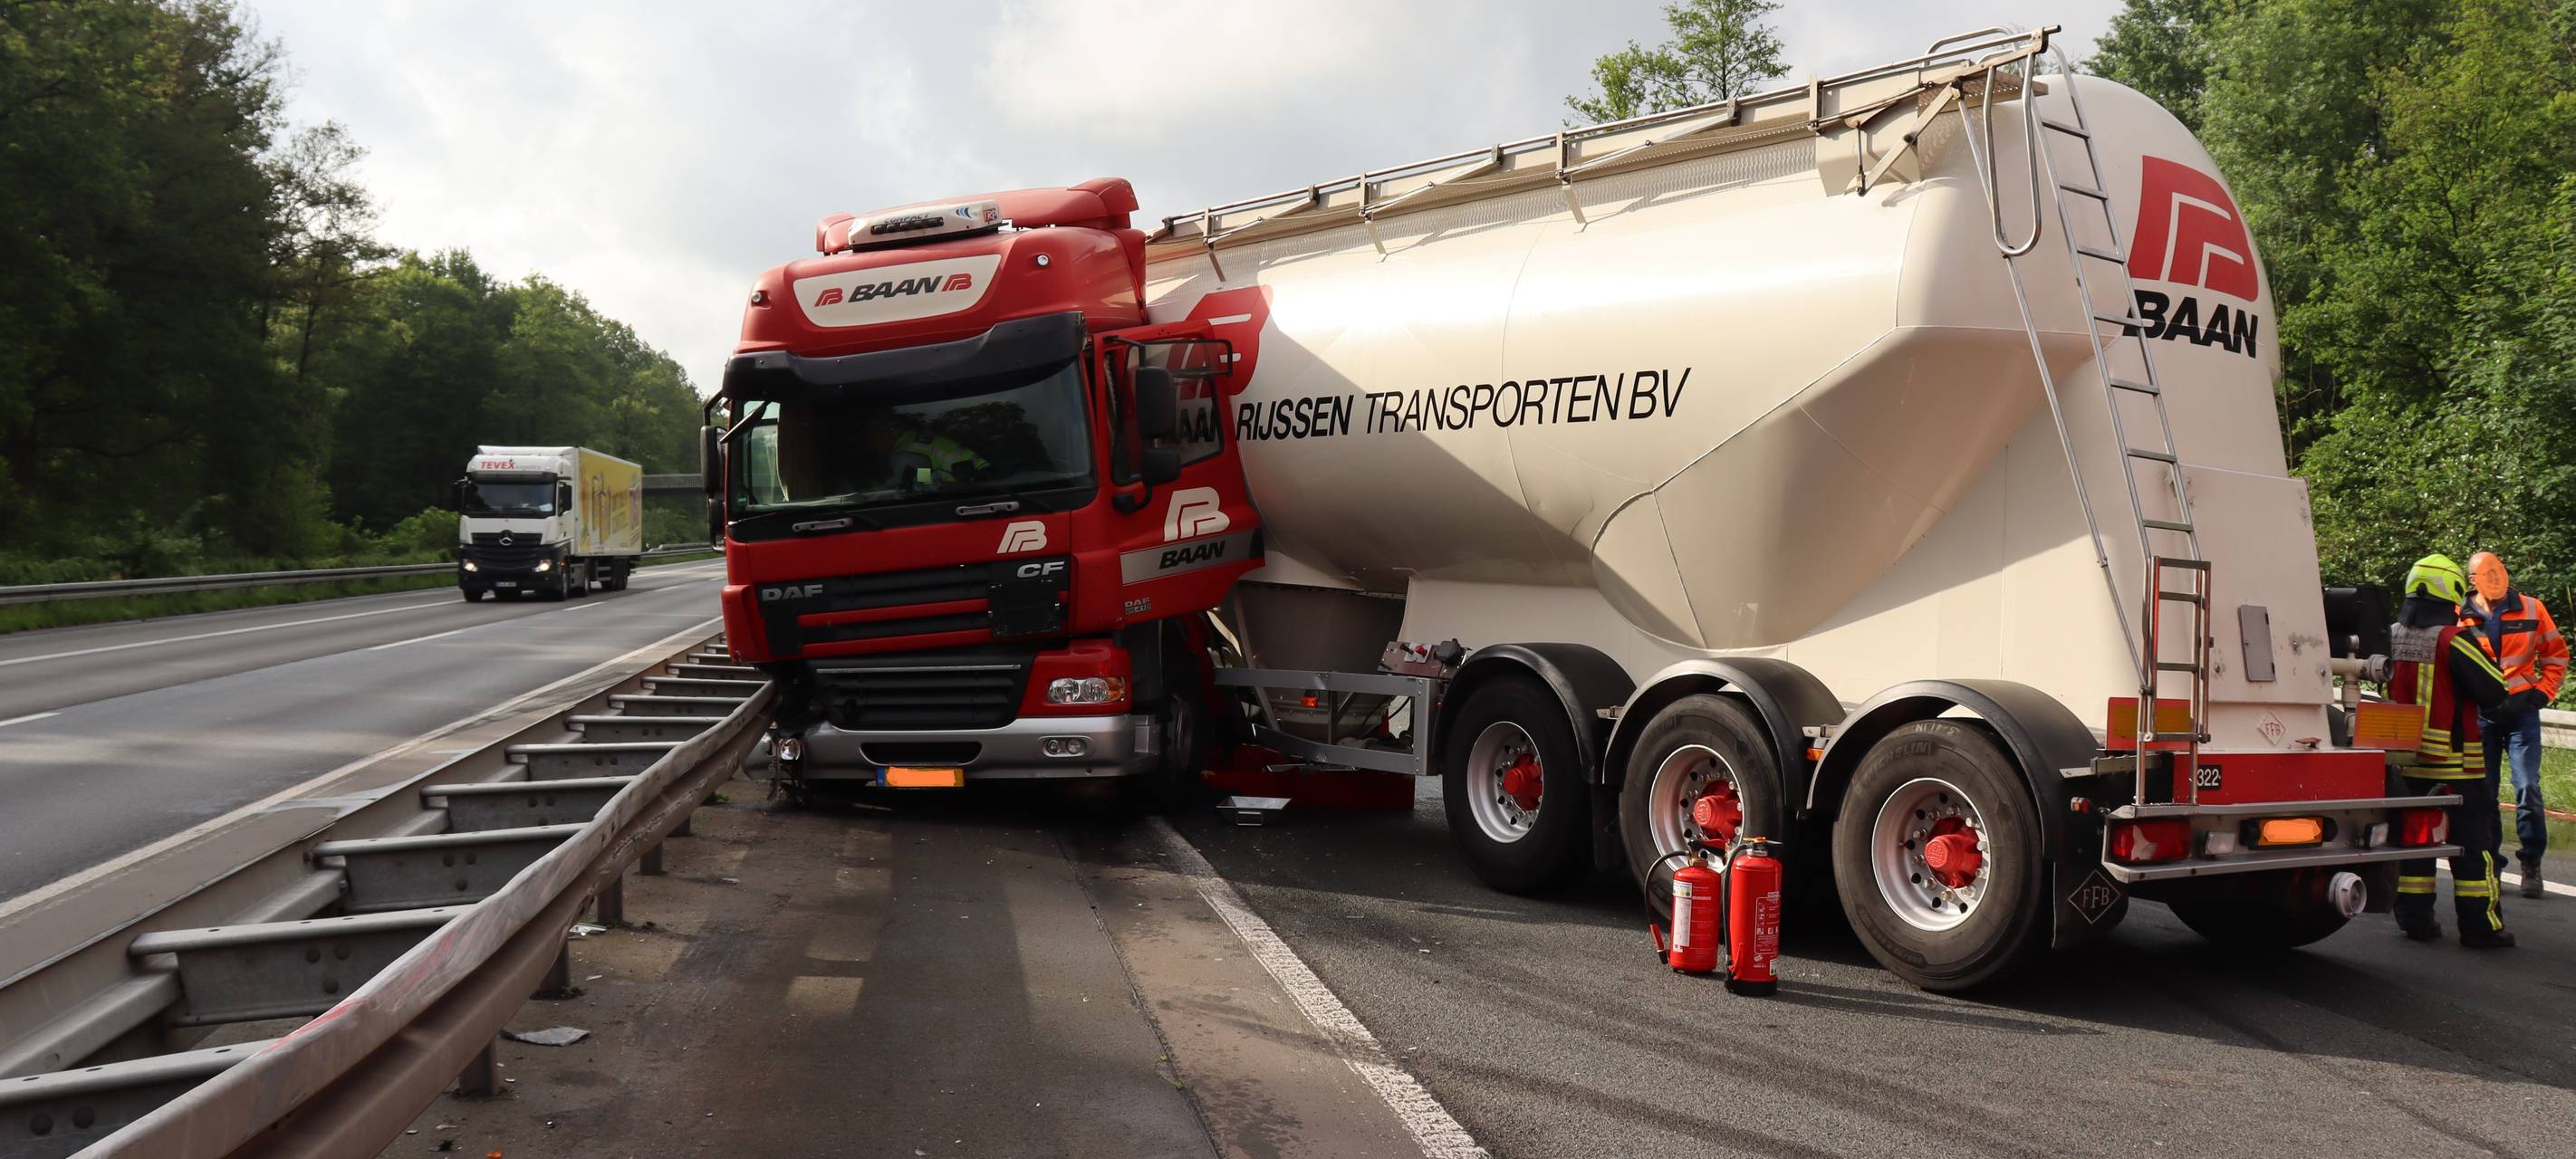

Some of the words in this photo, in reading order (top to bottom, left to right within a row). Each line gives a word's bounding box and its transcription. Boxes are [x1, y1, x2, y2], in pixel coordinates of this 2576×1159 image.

[847, 275, 943, 303] BAAN
[2121, 289, 2259, 359] BAAN
[1235, 393, 1354, 442] RIJSSEN
[1364, 372, 1624, 436] TRANSPORTEN
[1629, 367, 1693, 419] BV
[480, 460, 516, 470] TEVEX
[1158, 540, 1226, 570] BAAN
[1016, 560, 1065, 579] CF
[761, 583, 823, 602] DAF
[2082, 886, 2110, 909] FFB
